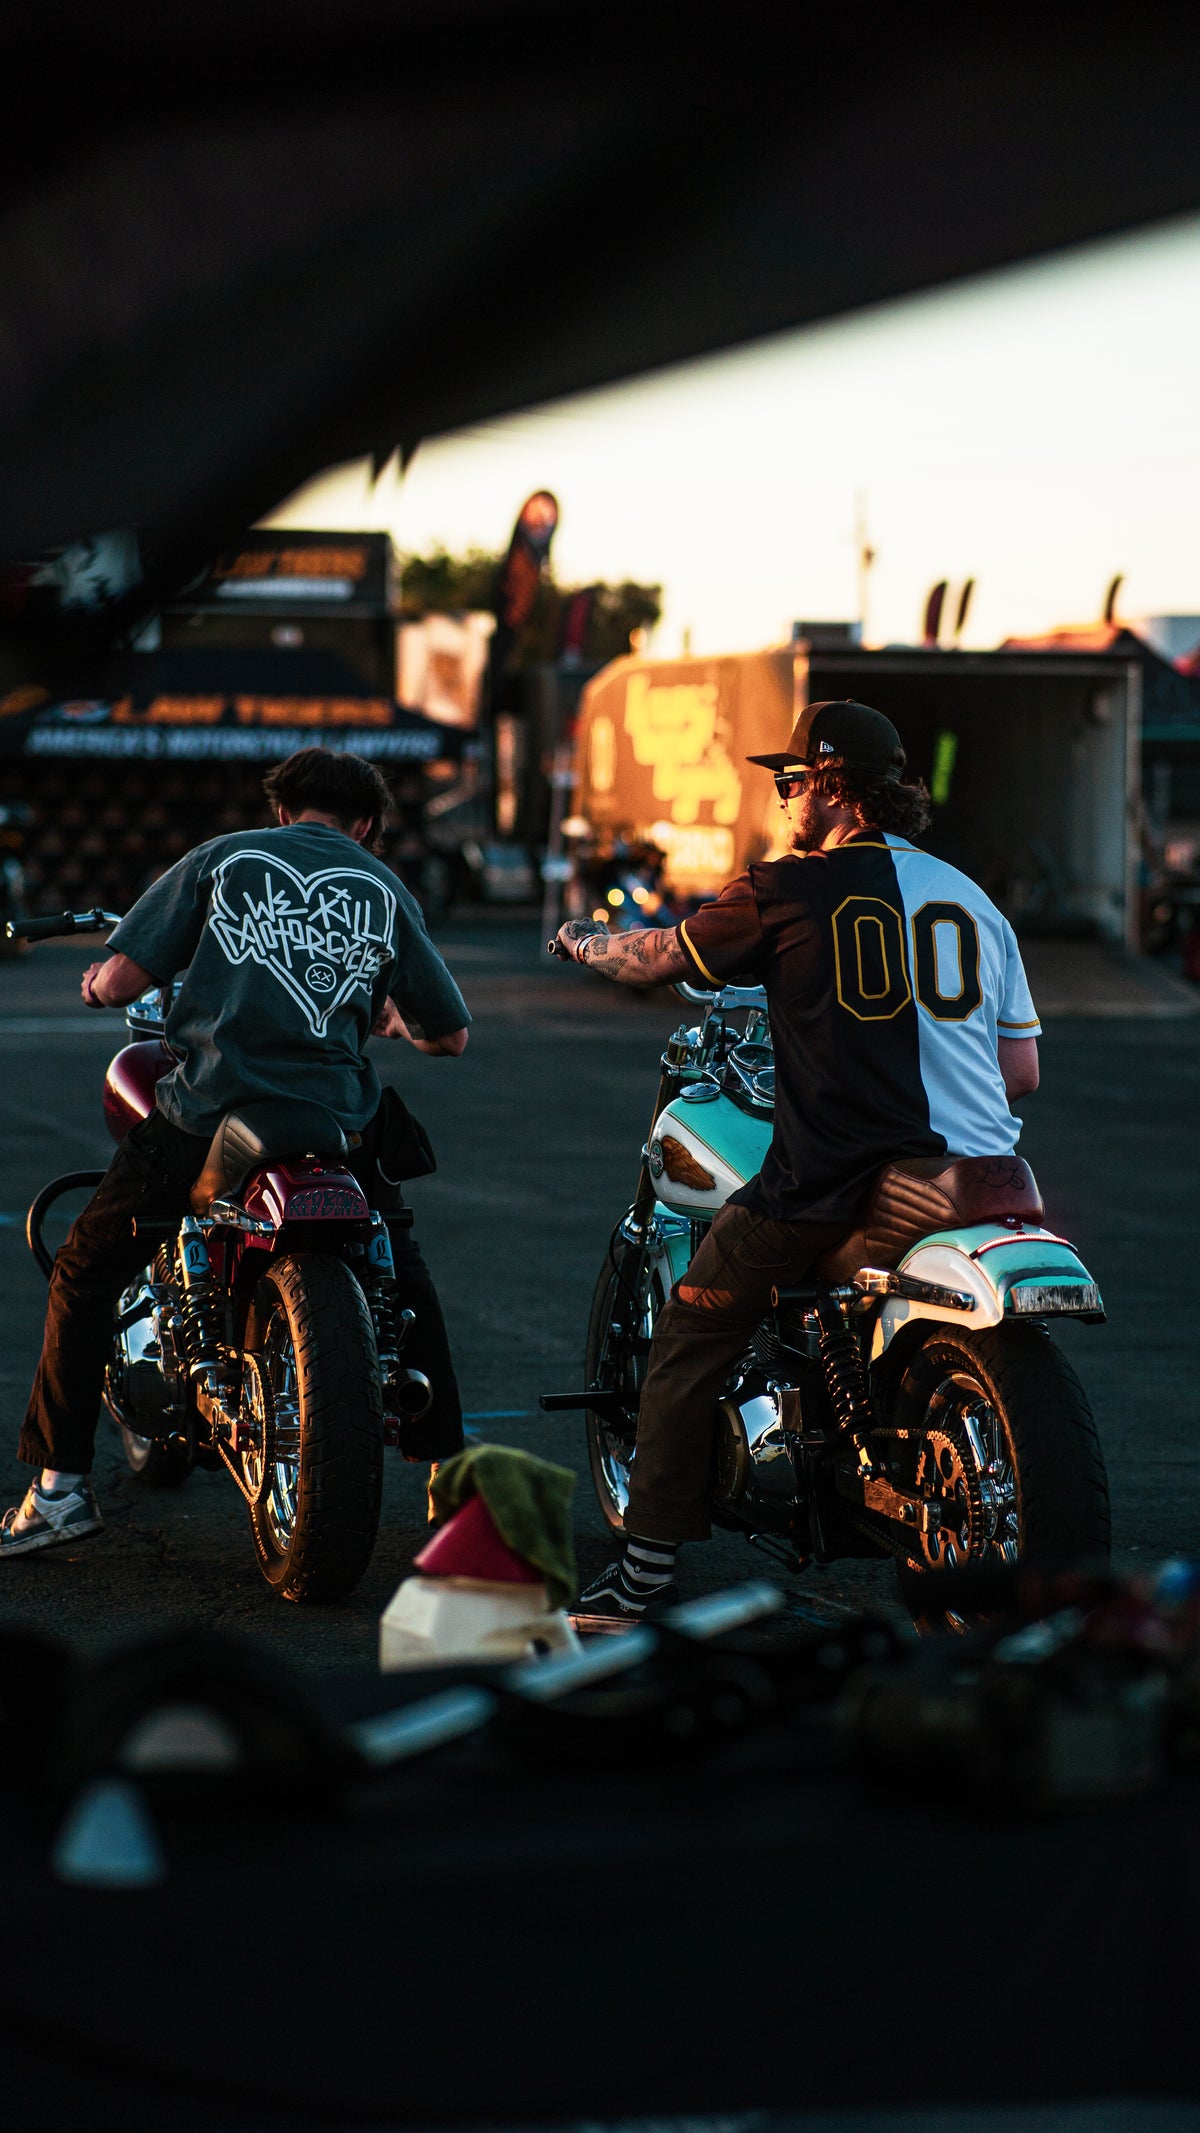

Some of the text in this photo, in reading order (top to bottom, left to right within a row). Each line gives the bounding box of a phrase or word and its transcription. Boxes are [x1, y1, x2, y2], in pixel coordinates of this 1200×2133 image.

[242, 872, 309, 922] WE
[831, 895, 984, 1022] 00
[289, 1189, 365, 1217] REDBONE
